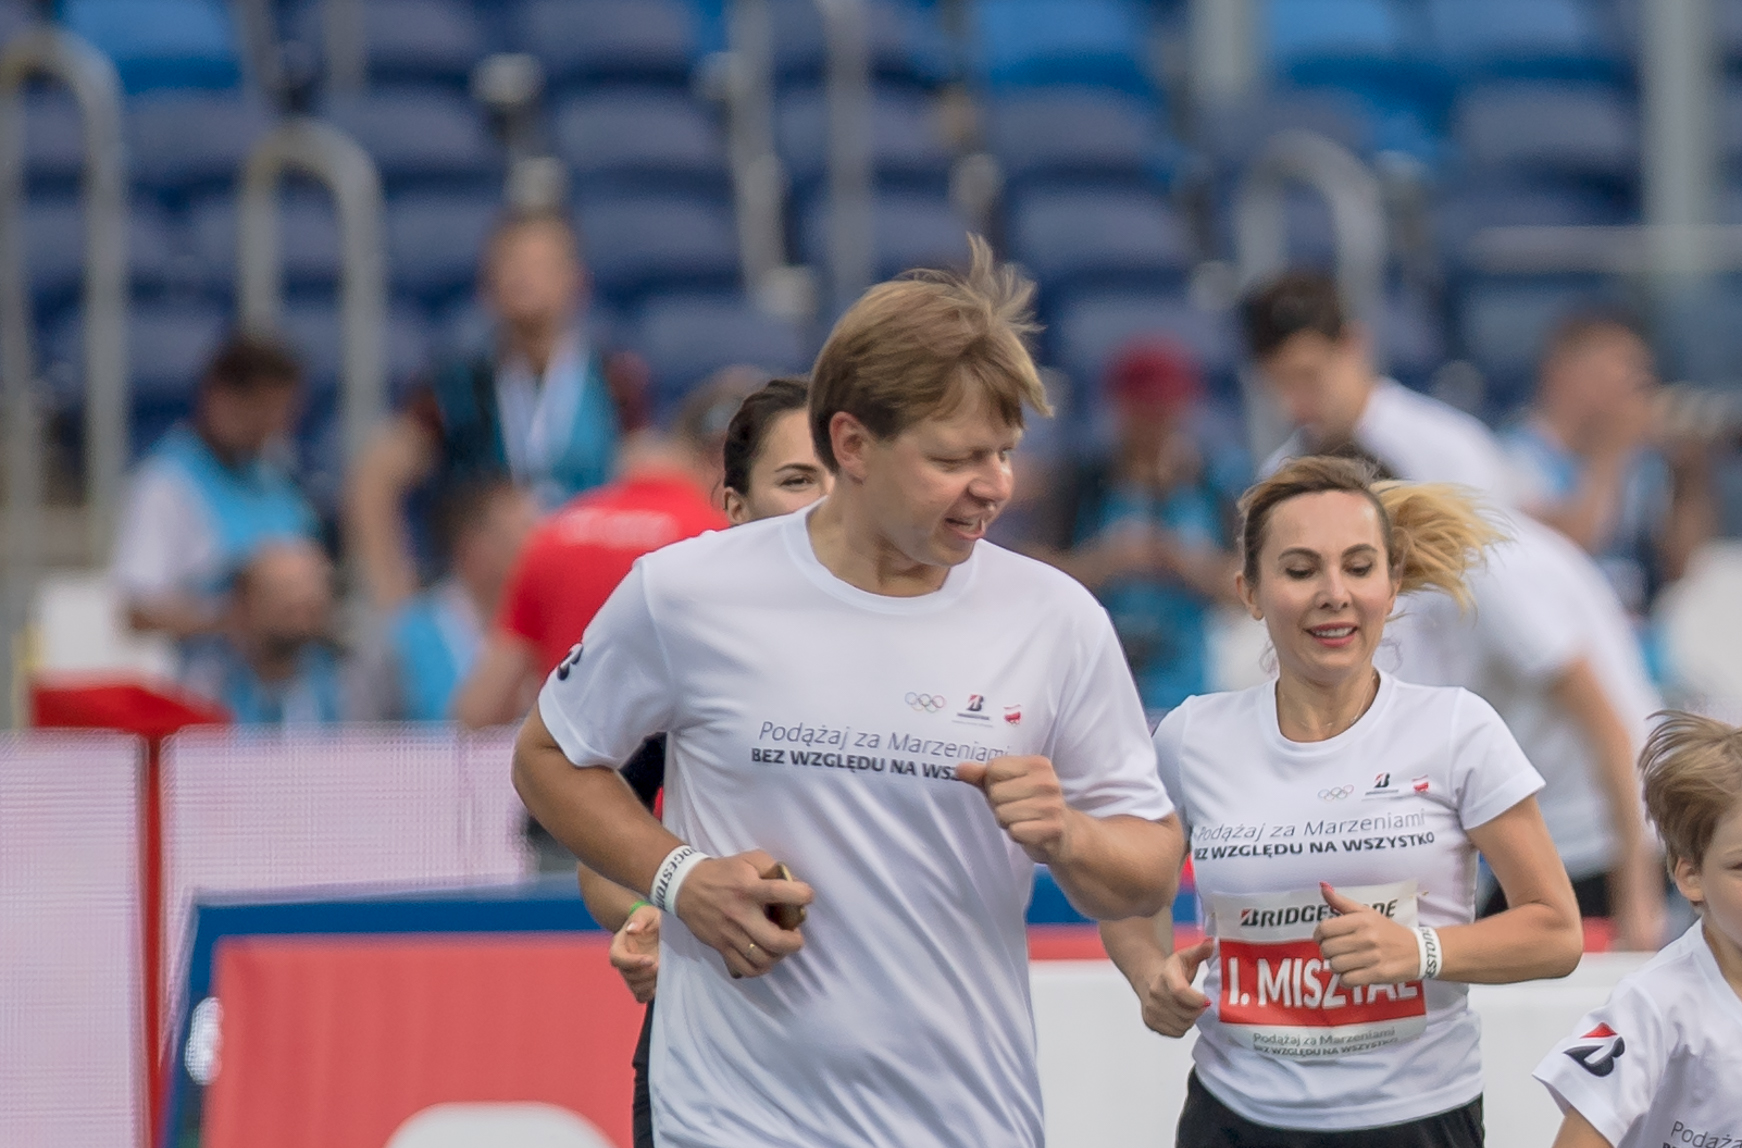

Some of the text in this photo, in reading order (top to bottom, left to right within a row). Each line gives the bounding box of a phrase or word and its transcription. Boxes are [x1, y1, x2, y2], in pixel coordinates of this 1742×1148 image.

[758, 721, 850, 750] Podążaj
[854, 731, 880, 748] za
[751, 748, 785, 765] BEZ
[790, 750, 885, 774] WZGLĘDU
[890, 760, 917, 776] NA
[1197, 808, 1426, 843] Podążaj za Marzeniami
[1211, 842, 1304, 860] WZGLĘDU
[1309, 841, 1338, 854] NA
[1343, 832, 1435, 852] WSZYSTKO
[1241, 899, 1398, 928] BRIDGESNE
[1228, 956, 1250, 1007] I.
[1304, 1037, 1317, 1046] za
[1323, 1047, 1339, 1056] NA
